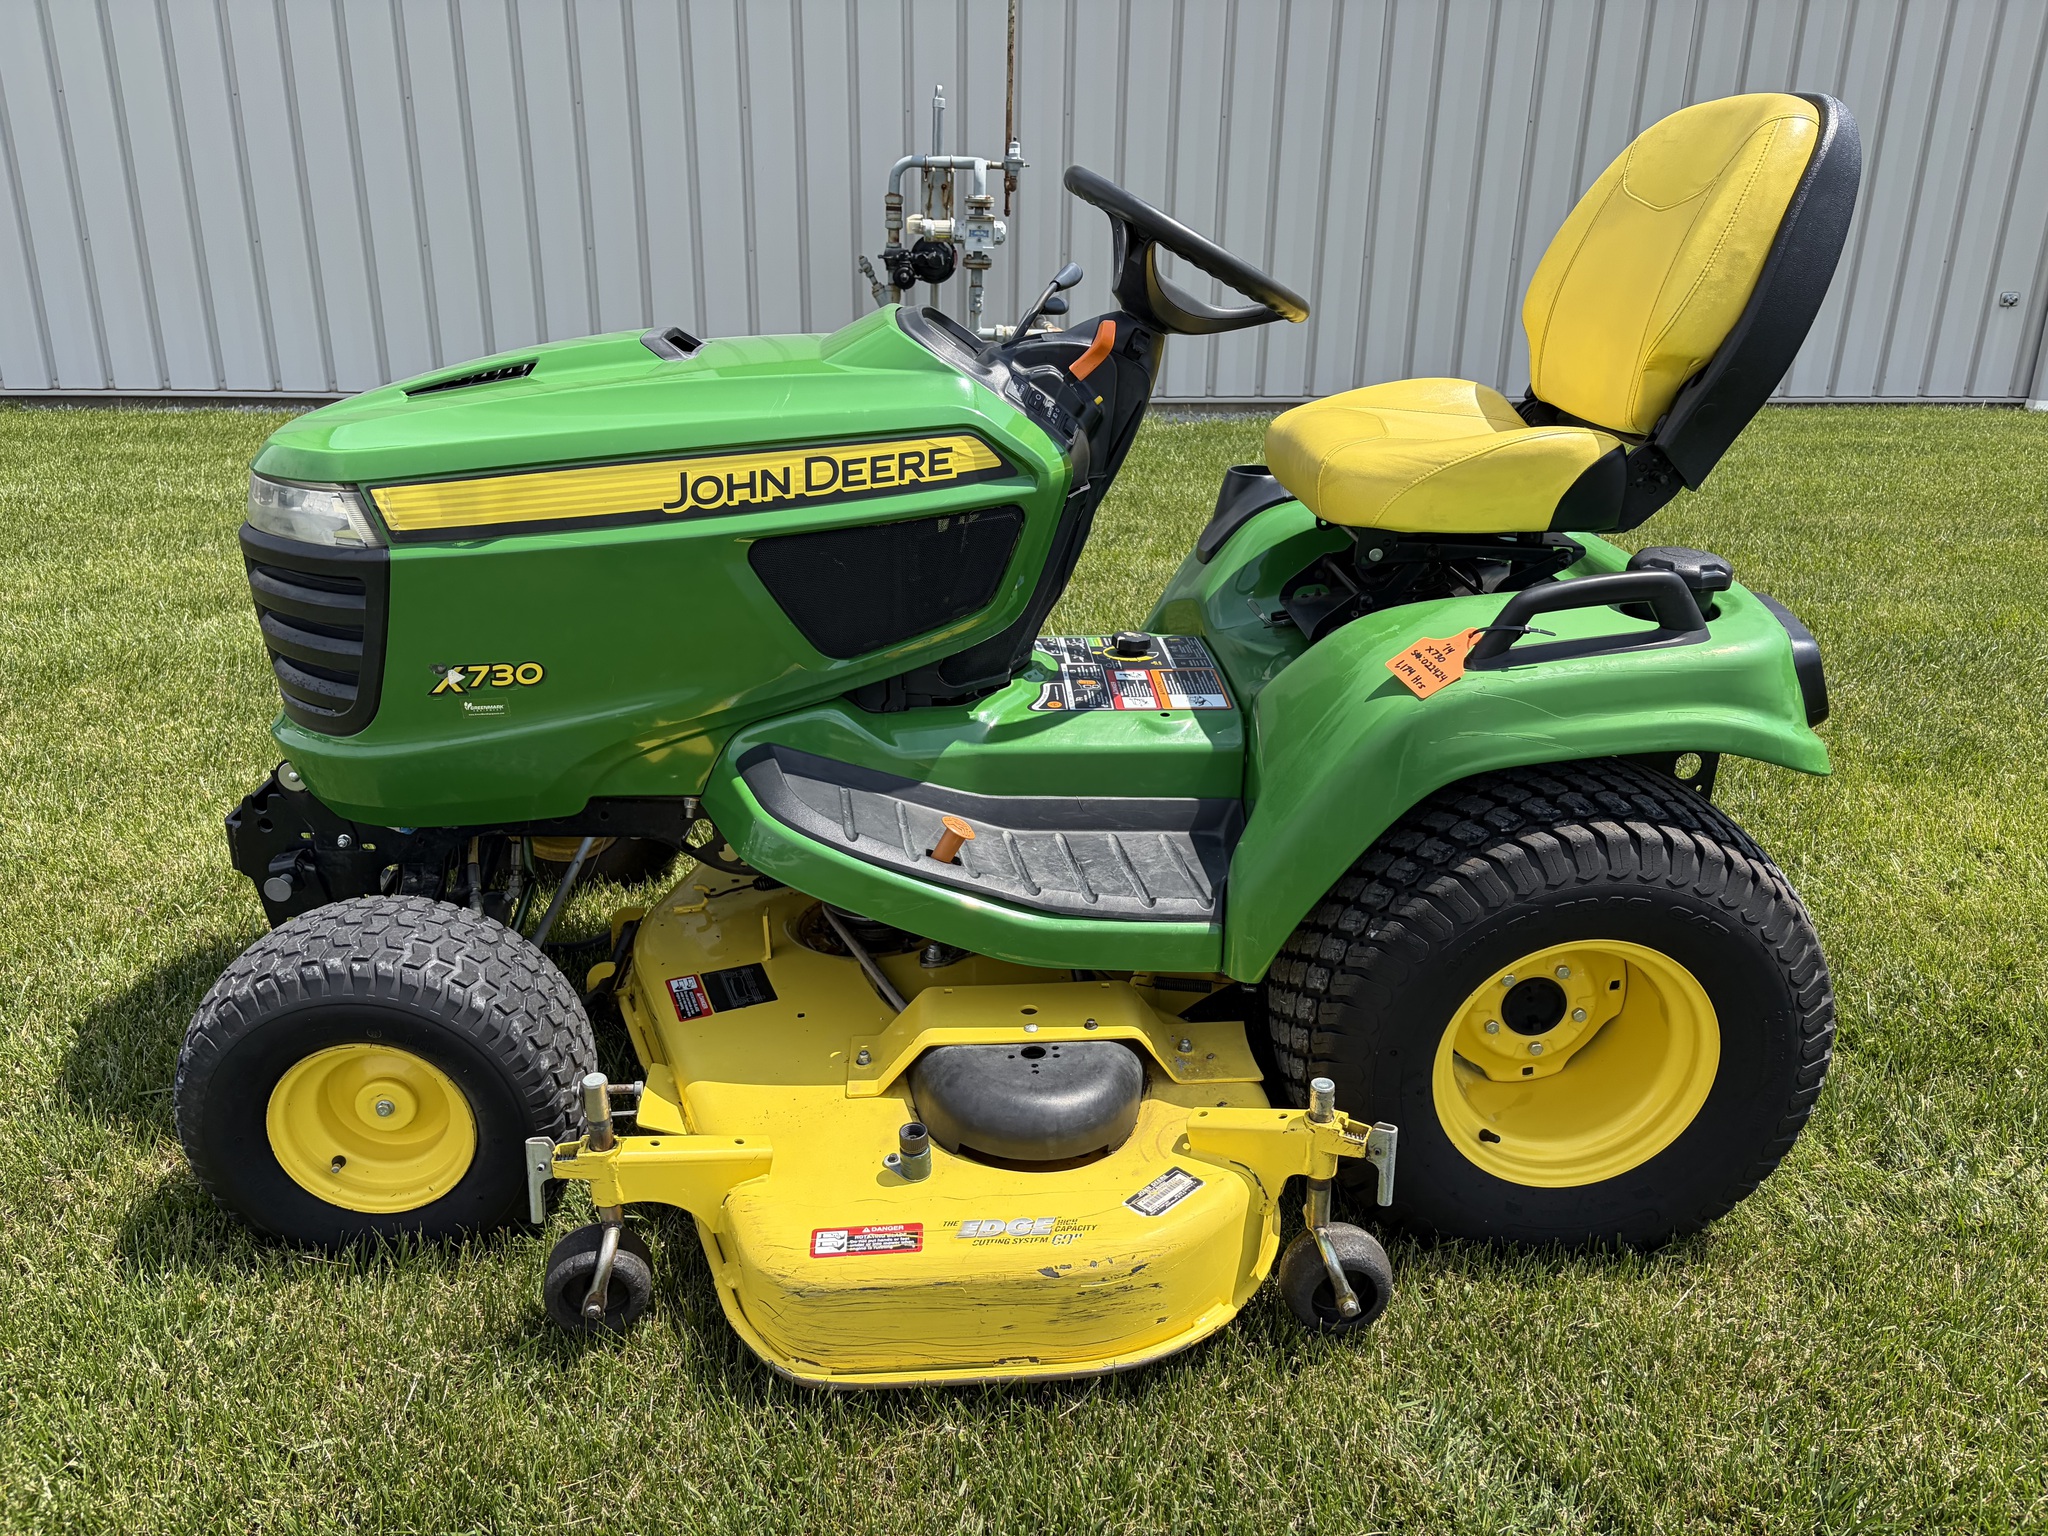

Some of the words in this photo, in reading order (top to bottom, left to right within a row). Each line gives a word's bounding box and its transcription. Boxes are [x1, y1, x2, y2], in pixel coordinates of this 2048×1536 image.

[663, 466, 793, 513] JOHN
[803, 446, 956, 496] DEERE
[1425, 646, 1446, 663] X730
[428, 661, 545, 695] X730
[1411, 675, 1426, 690] Hrs
[955, 1217, 1056, 1238] EDGE
[1055, 1224, 1098, 1232] CAPACITY
[1012, 1237, 1049, 1245] SYSTEM
